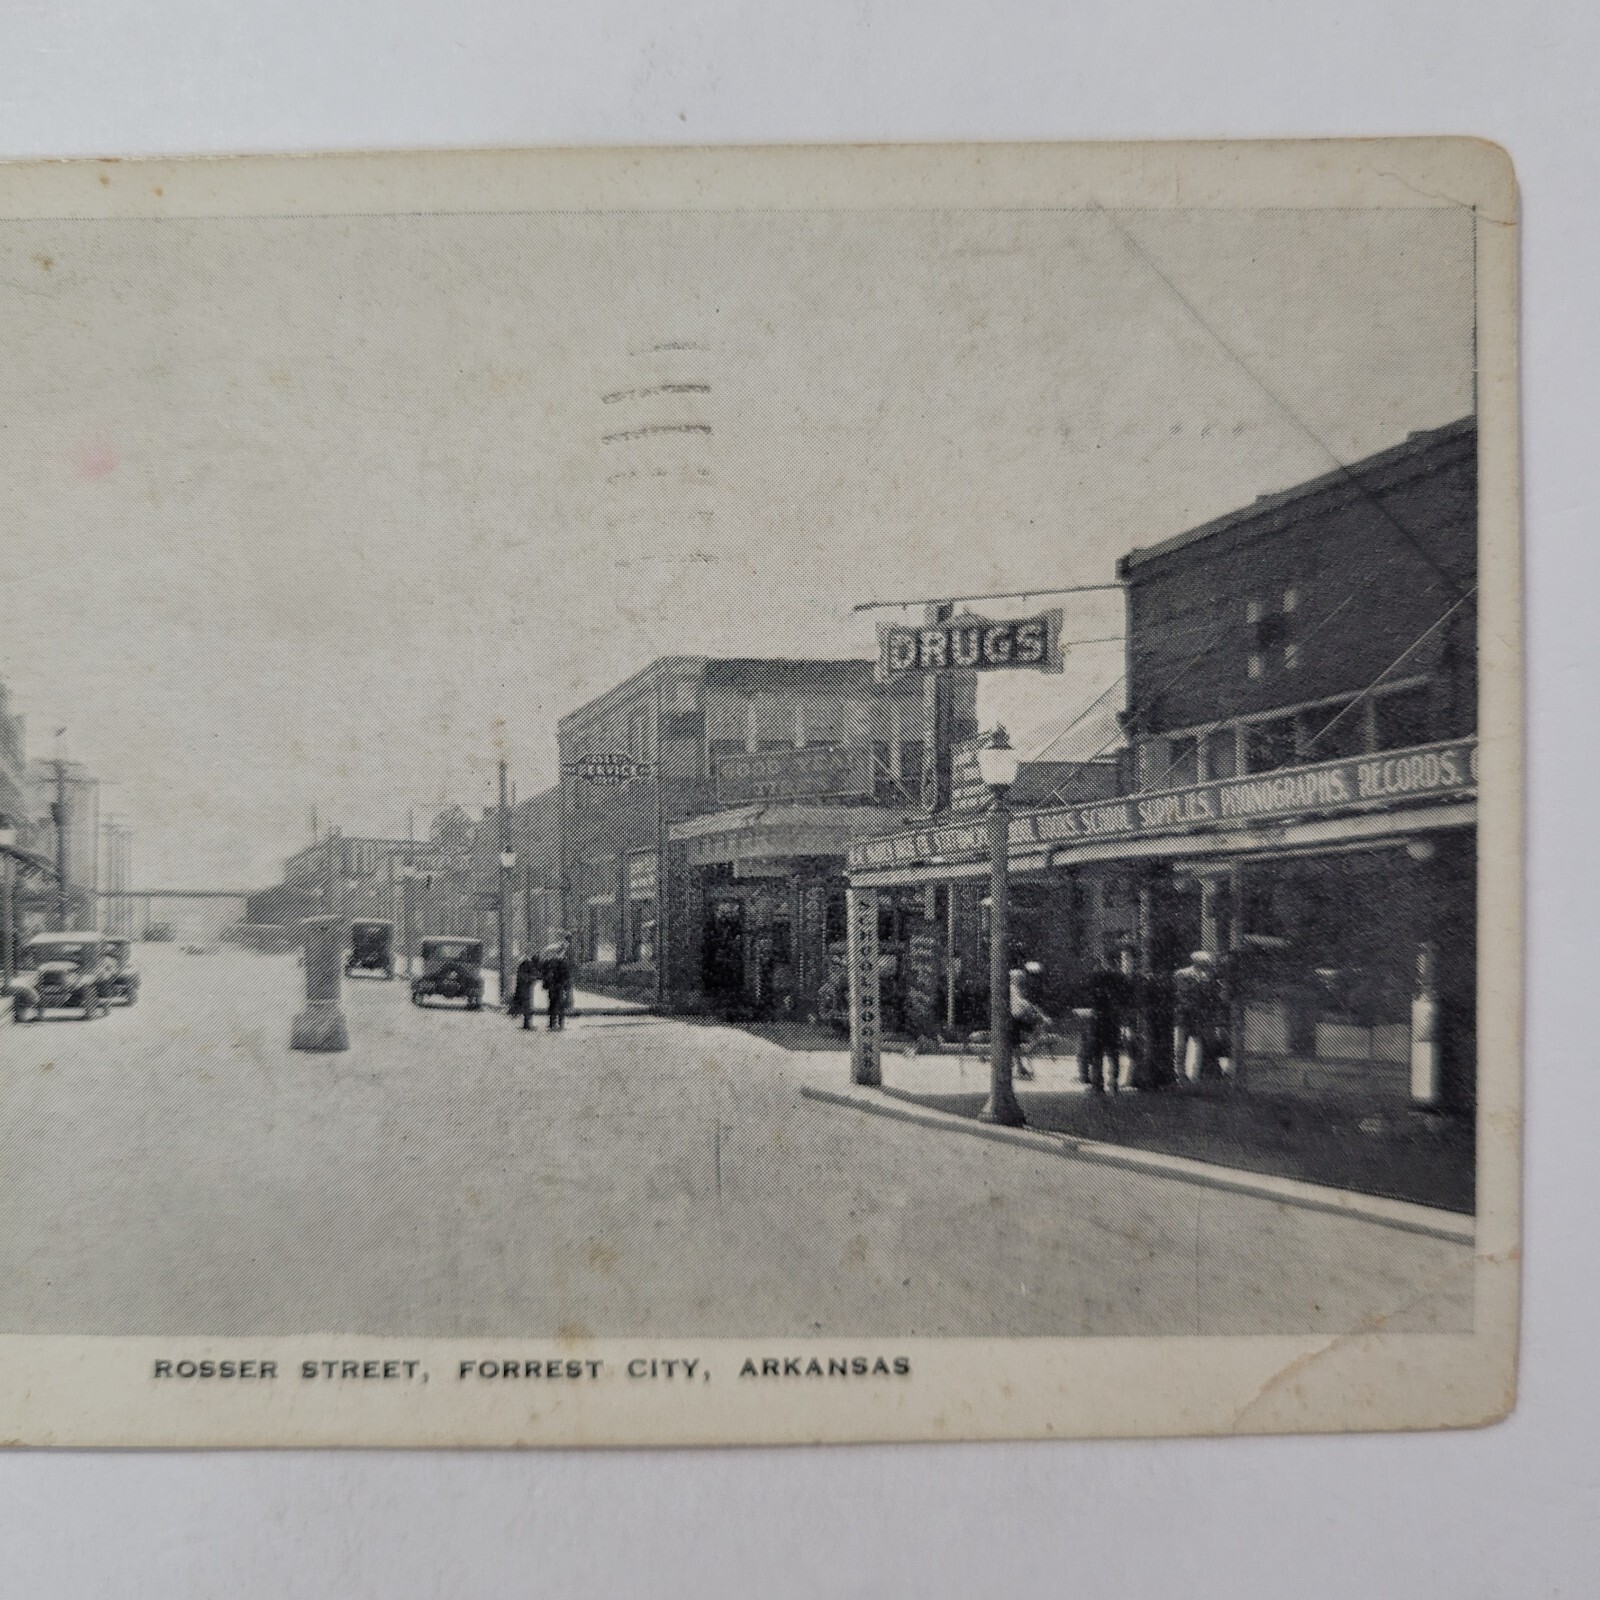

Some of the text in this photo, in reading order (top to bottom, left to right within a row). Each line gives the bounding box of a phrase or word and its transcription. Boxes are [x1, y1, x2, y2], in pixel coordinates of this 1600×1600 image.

[887, 624, 1044, 671] DRUGS
[153, 1356, 911, 1383] ROSSER STREET, FORREST CITY, ARKANSAS
